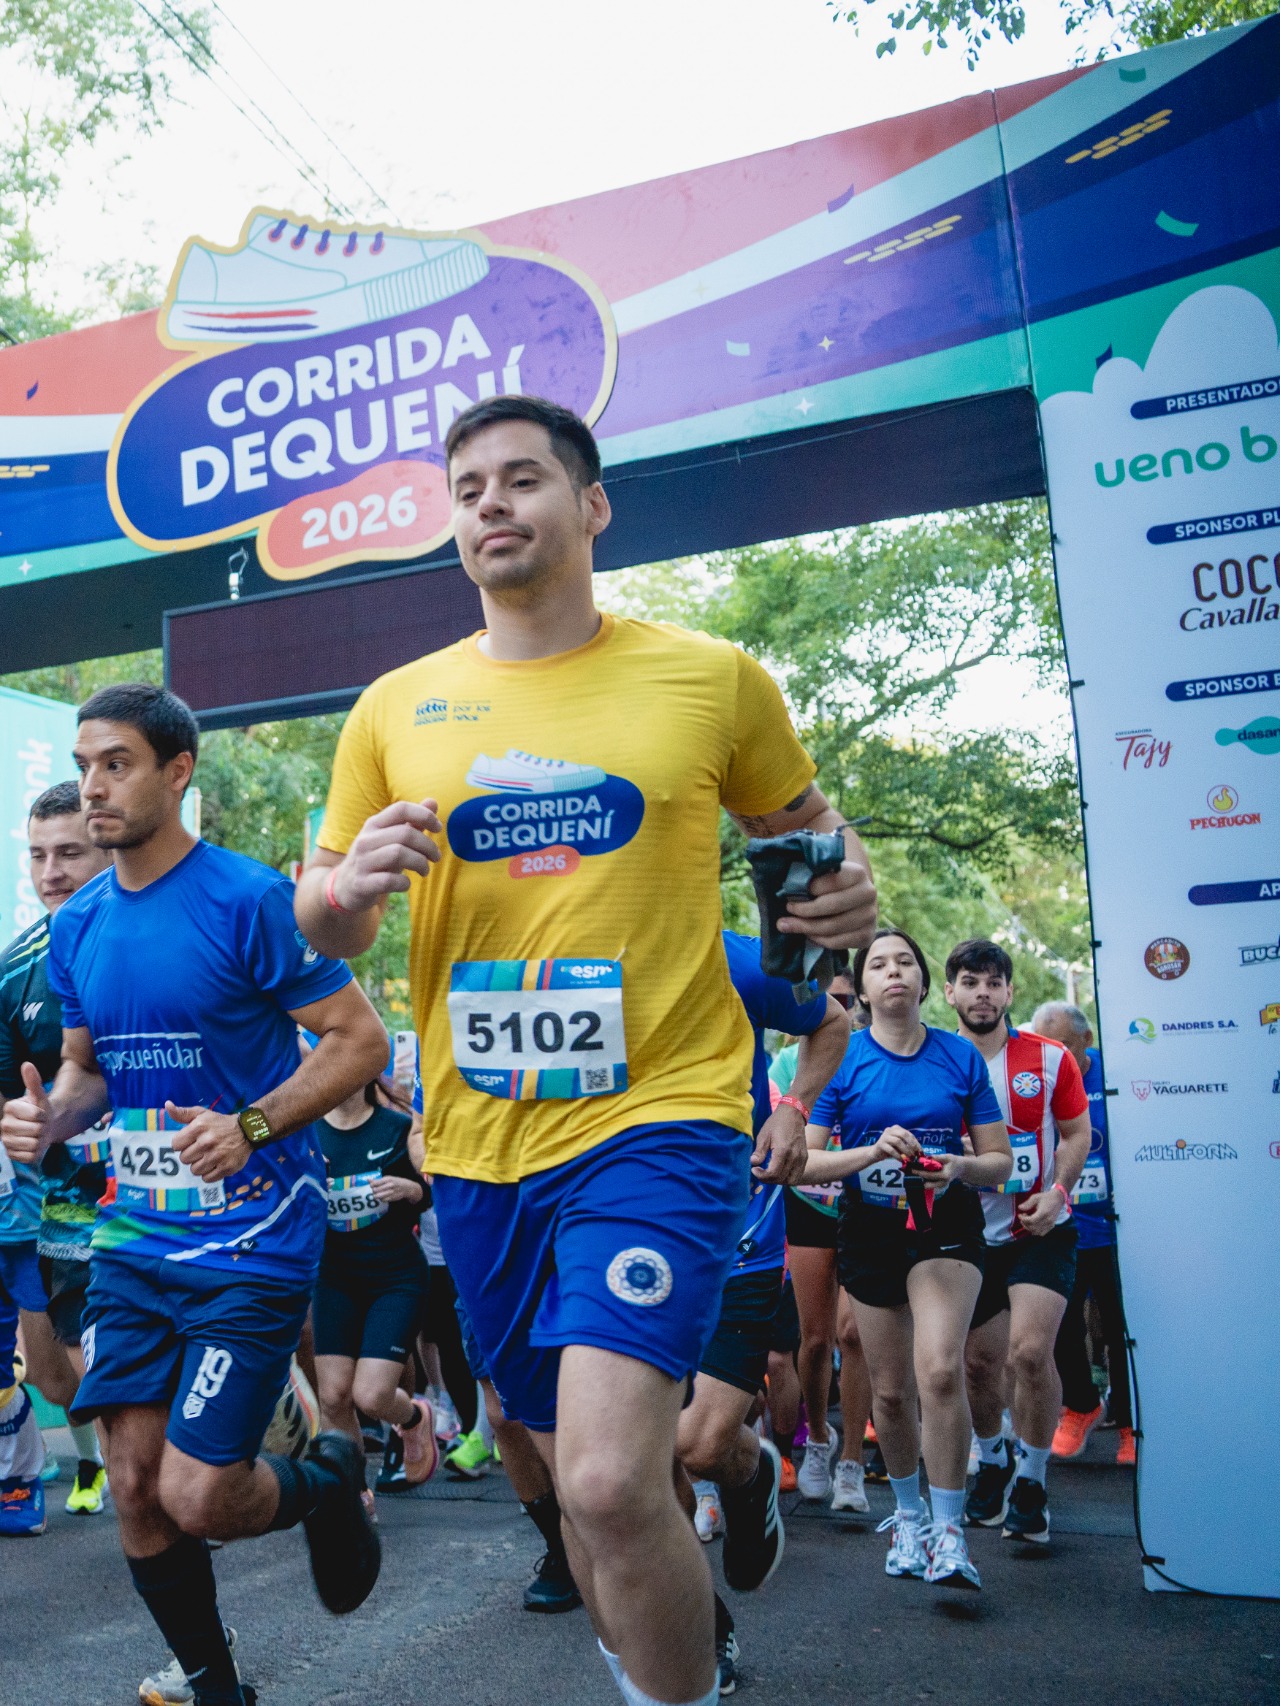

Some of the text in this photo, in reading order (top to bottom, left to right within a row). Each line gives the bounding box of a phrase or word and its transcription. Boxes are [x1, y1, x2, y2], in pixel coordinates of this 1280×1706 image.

[207, 314, 491, 427] CORRIDA
[1166, 380, 1280, 412] PRESENTADO
[1094, 442, 1230, 488] ueno
[301, 486, 418, 549] 2026
[1175, 514, 1258, 538] SPONSOR
[1192, 551, 1280, 603] COC
[1185, 674, 1270, 697] SPONSOR
[1115, 734, 1173, 771] Tajy
[483, 794, 602, 824] CORRIDA
[1189, 813, 1261, 831] PECHUGON
[473, 809, 615, 850] DEQUENÍ
[521, 854, 567, 874] 2026
[1241, 945, 1280, 963] BUC
[467, 1010, 604, 1053] 5102
[1162, 1019, 1239, 1031] DANDRES S.A.
[1153, 1083, 1228, 1095] YAGUARETE
[120, 1145, 180, 1177] 425
[866, 1168, 903, 1188] 42
[328, 1193, 379, 1215] 3658
